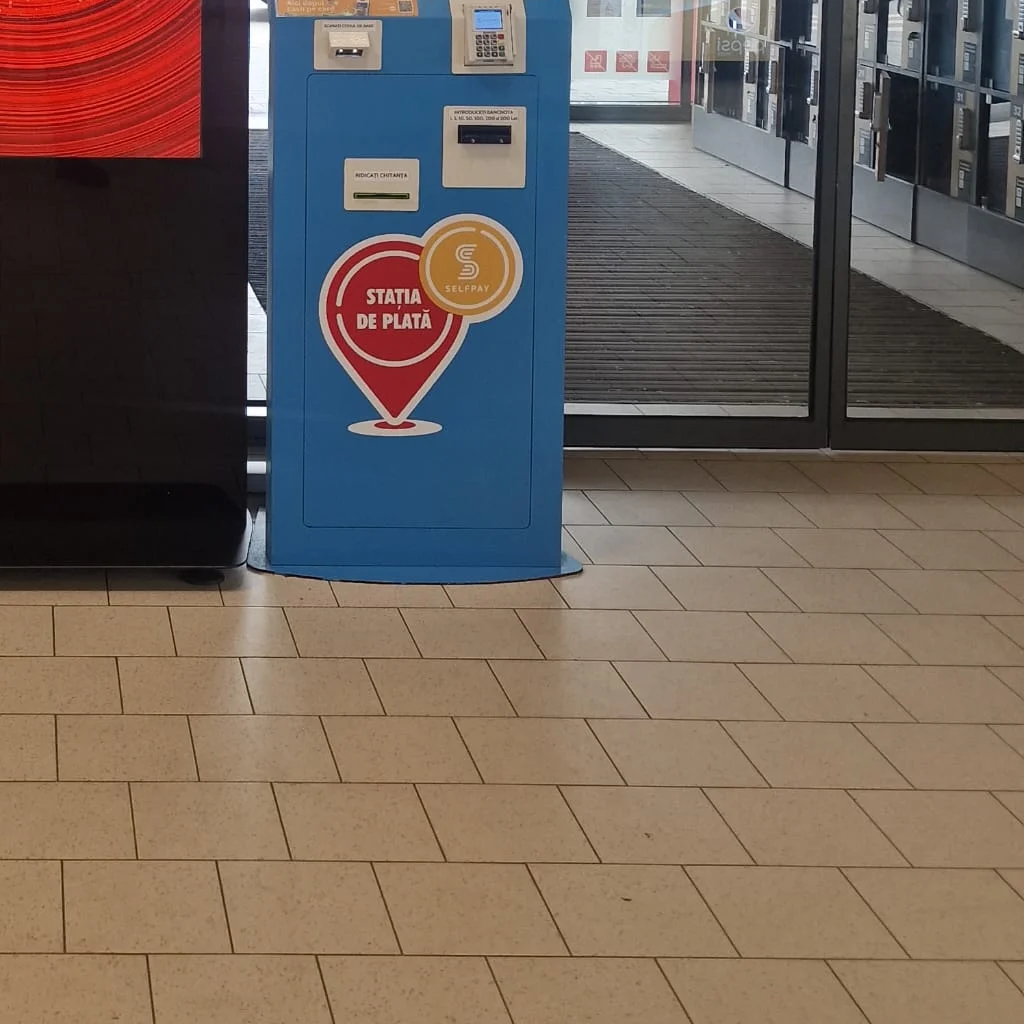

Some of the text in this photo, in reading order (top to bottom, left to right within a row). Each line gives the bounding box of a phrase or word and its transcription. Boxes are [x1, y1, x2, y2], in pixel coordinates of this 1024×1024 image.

[366, 288, 422, 310] STAȚIA
[445, 285, 490, 293] SELFPAY
[356, 309, 432, 330] DE PLATĂ
